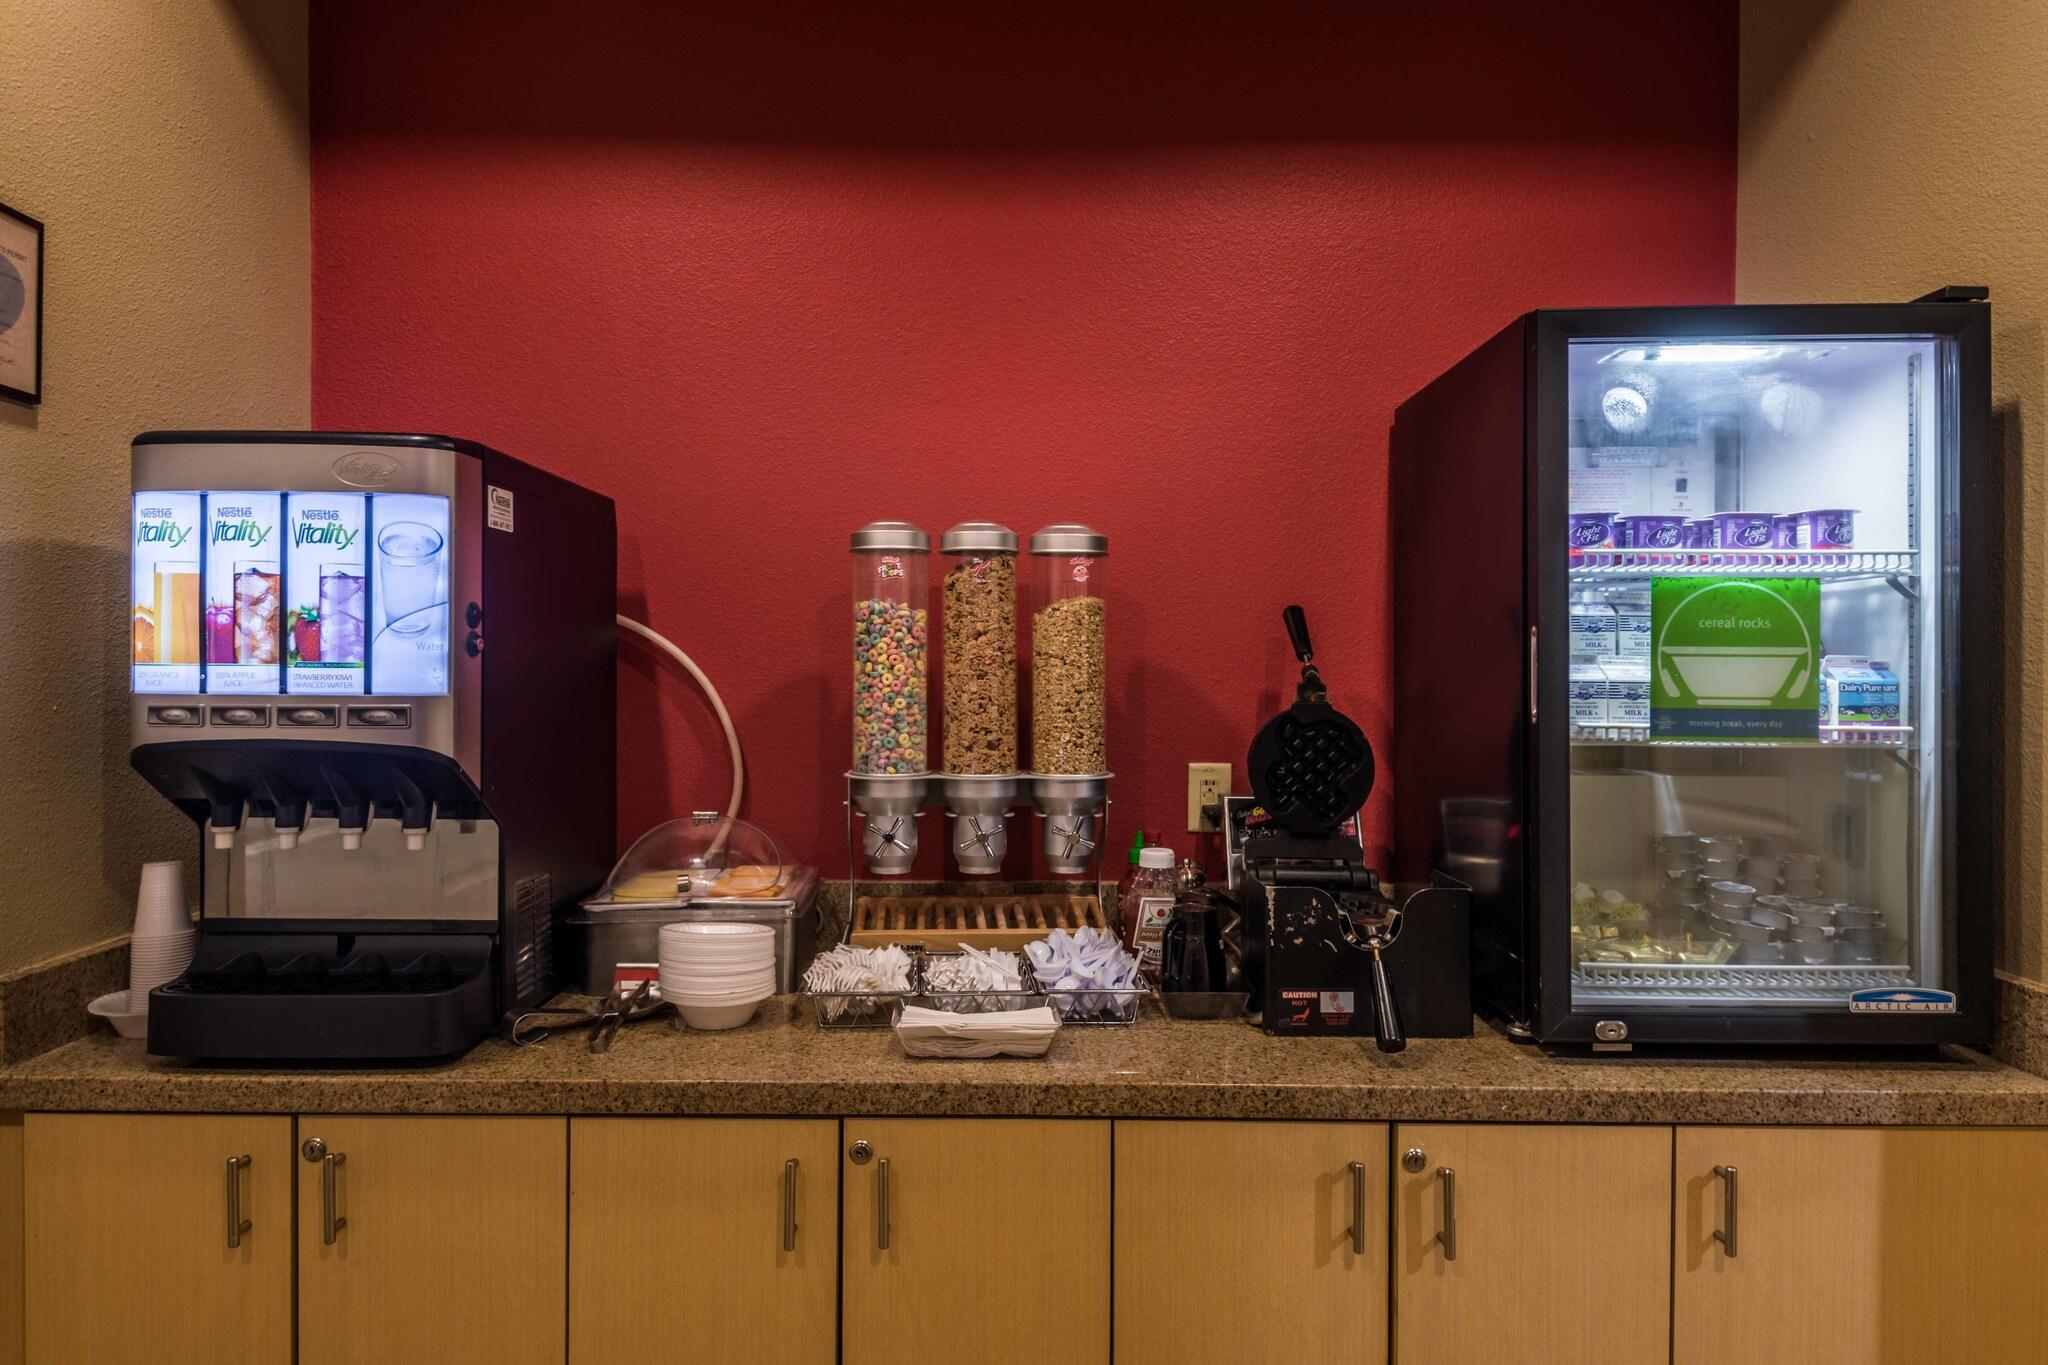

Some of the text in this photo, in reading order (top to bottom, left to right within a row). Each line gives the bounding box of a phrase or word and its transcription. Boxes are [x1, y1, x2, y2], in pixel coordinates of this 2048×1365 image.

[209, 513, 273, 548] Vitality
[292, 516, 360, 551] Vitality
[1576, 525, 1601, 538] Light
[1656, 528, 1678, 538] Light
[1744, 526, 1768, 538] Light
[1587, 533, 1600, 544] Fit
[1665, 536, 1677, 545] Fit
[1754, 534, 1766, 543] Fit
[1698, 616, 1772, 629] cereal rocks
[415, 639, 445, 652] Water
[1689, 719, 1720, 729] morning
[1747, 720, 1767, 730] every
[1768, 719, 1783, 729] day
[1282, 991, 1318, 999] CAUTION
[1854, 1002, 1950, 1010] ARCTIC AIR
